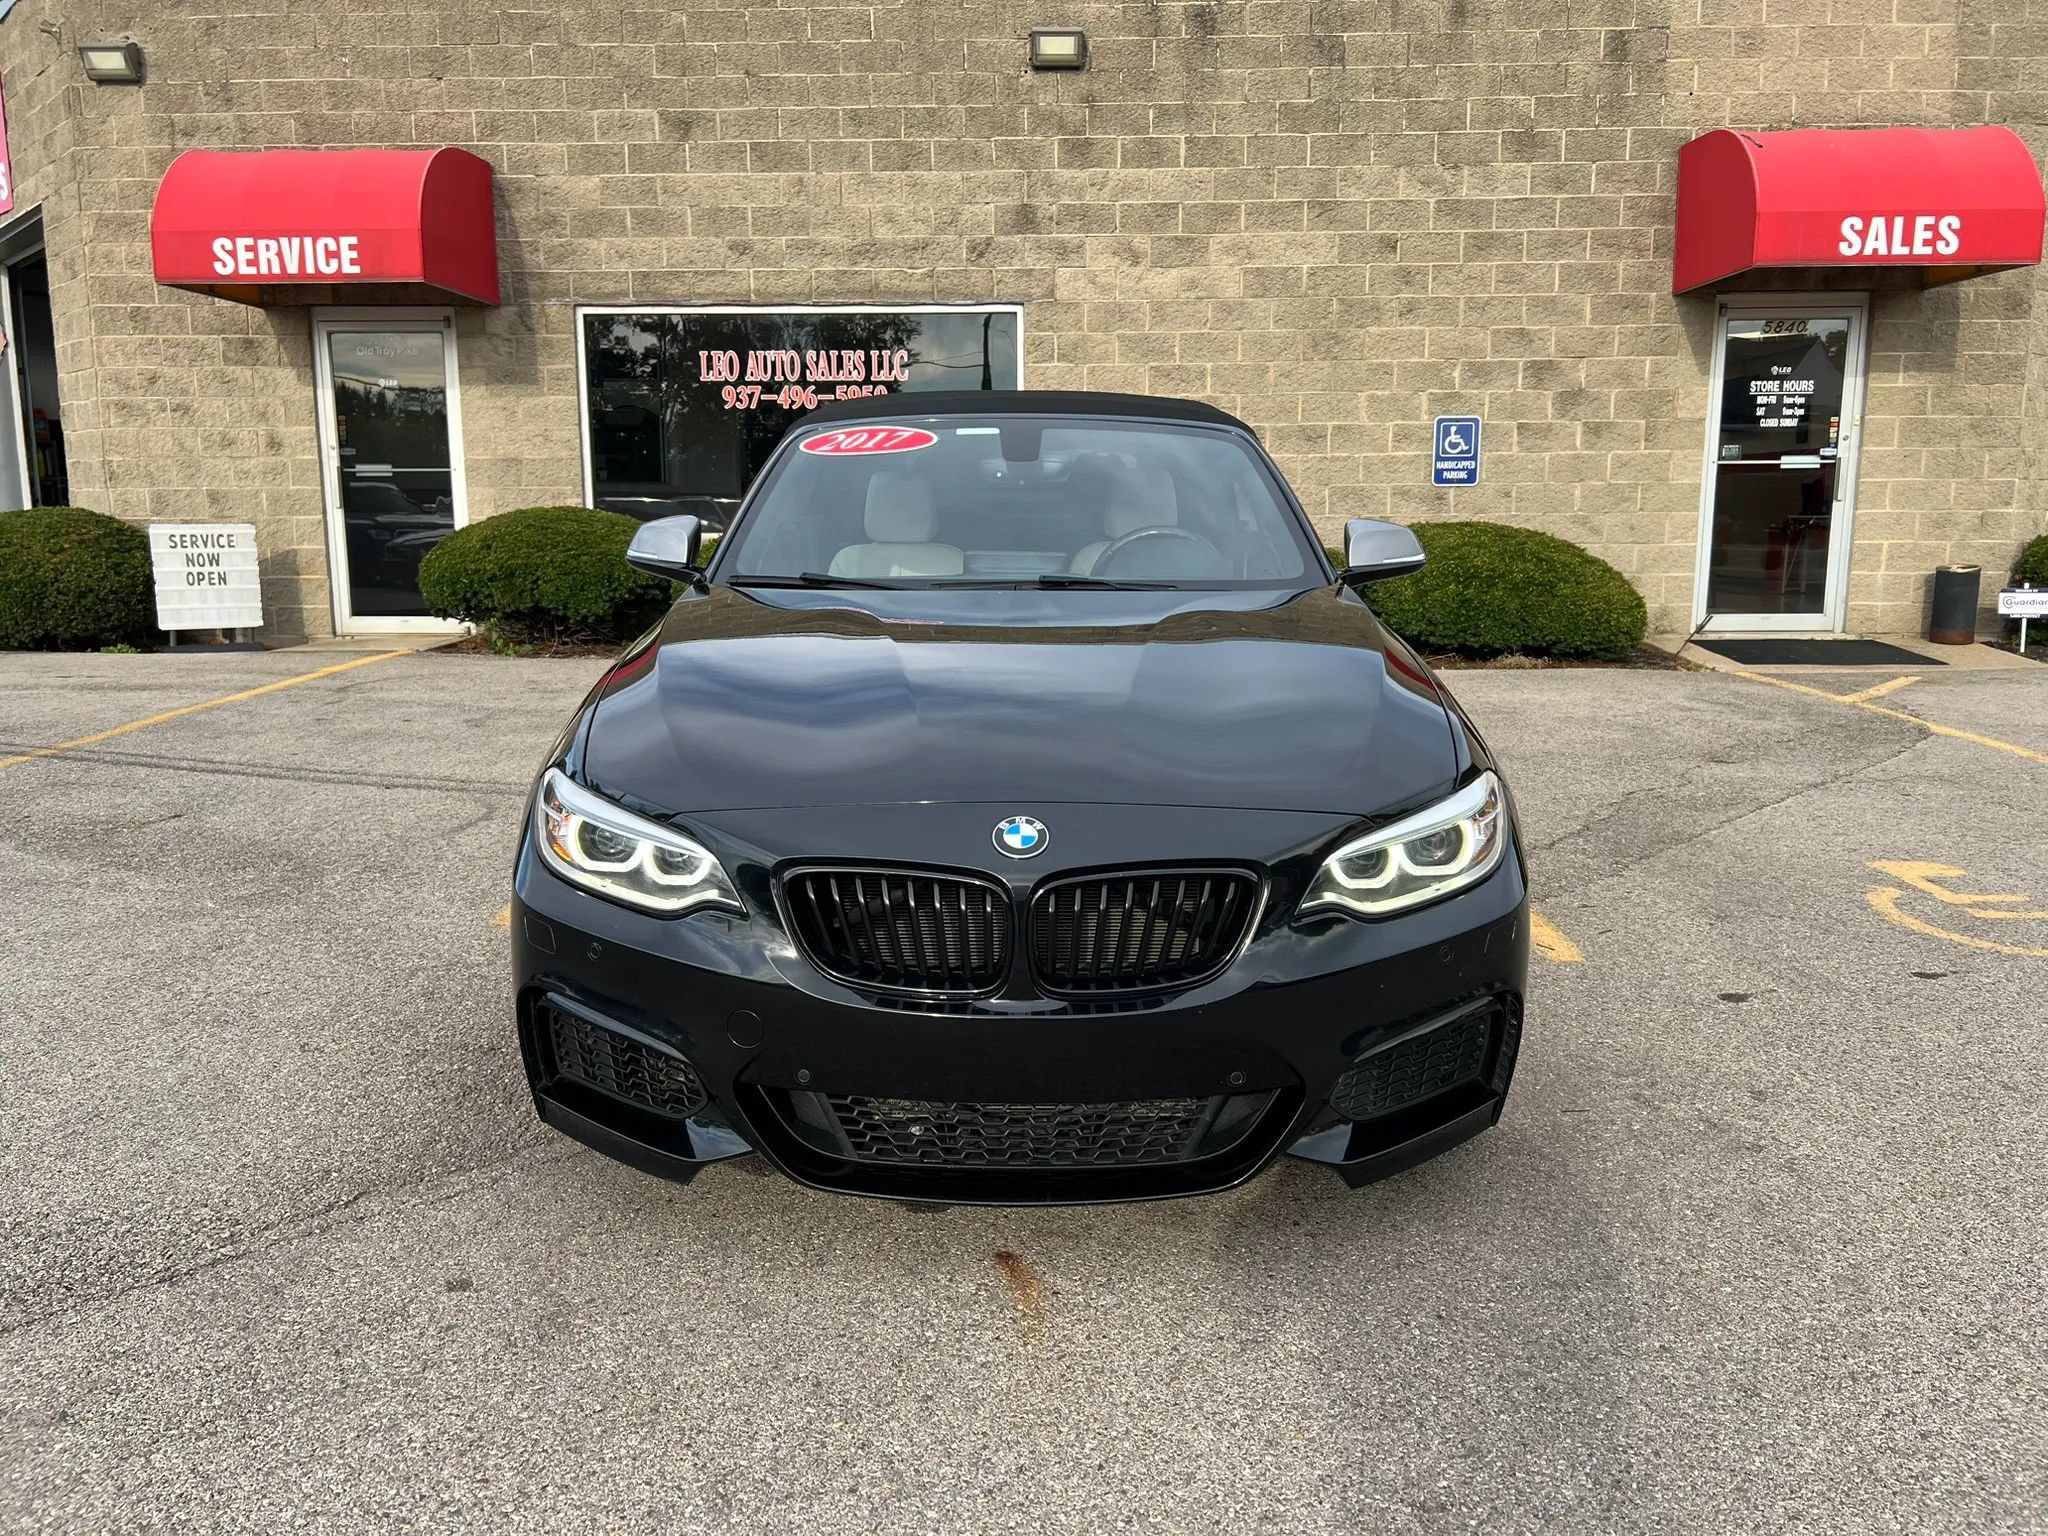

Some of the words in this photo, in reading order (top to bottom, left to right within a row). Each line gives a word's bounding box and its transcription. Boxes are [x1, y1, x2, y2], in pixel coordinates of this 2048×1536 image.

[1838, 215, 1961, 256] SALES
[212, 236, 361, 276] SERVICE
[1762, 320, 1806, 334] 5840
[356, 345, 374, 356] Old
[375, 345, 395, 358] Troy
[699, 350, 740, 382] LEO
[745, 350, 800, 382] AUTO
[806, 350, 866, 382] SALES
[870, 350, 909, 382] LLC
[1749, 380, 1781, 392] STORE
[1782, 380, 1815, 392] HOURS
[1755, 406, 1766, 416] SAT
[1759, 418, 1779, 427] CLOSED
[1779, 418, 1799, 427] SUNDAY
[823, 431, 916, 450] 2017
[1436, 461, 1476, 469] HANDICAPPED
[1442, 471, 1468, 479] PARKING
[168, 534, 236, 549] SERVICE
[185, 552, 220, 568] NOW
[186, 571, 228, 586] OPEN
